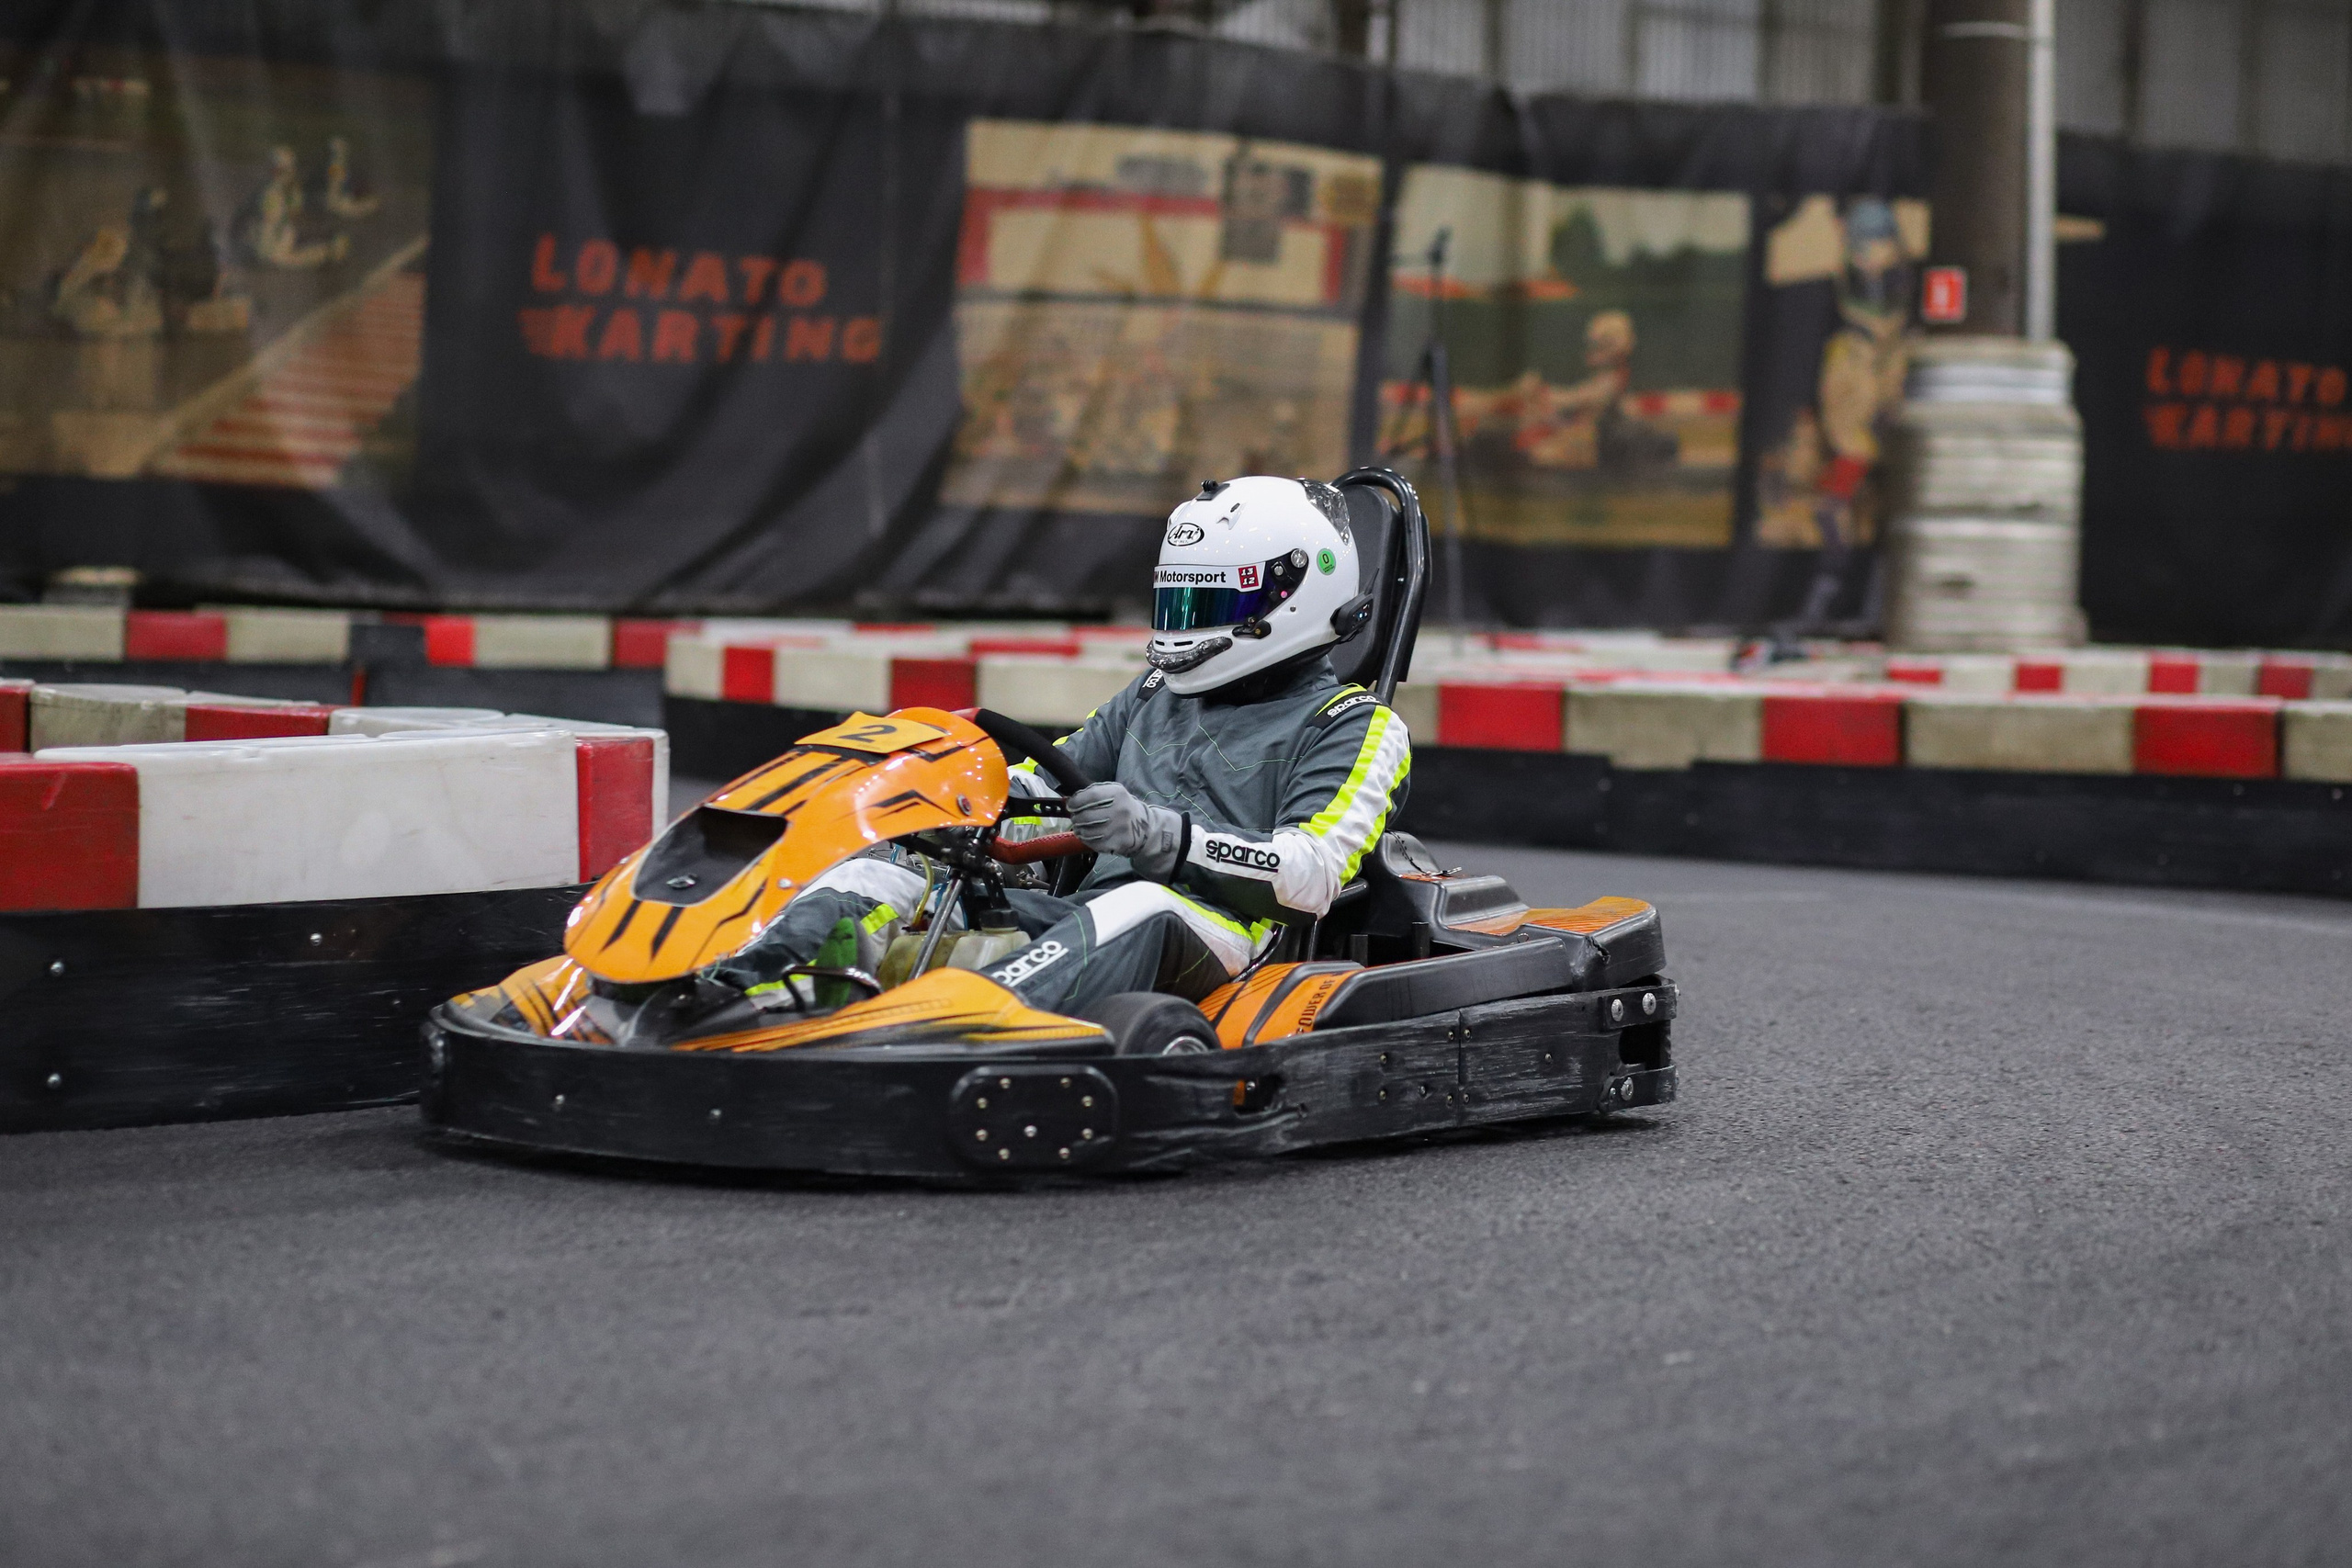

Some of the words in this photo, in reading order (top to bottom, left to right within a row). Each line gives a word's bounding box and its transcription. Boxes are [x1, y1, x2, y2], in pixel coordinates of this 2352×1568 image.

[531, 231, 828, 307] LONATO
[516, 304, 883, 364] KARTING
[2146, 346, 2347, 406] LONATO
[1168, 525, 1201, 541] Arai
[1159, 570, 1227, 585] Motorsport
[1241, 568, 1254, 576] 13
[1242, 577, 1255, 585] 12
[1327, 695, 1381, 717] sparco
[836, 724, 898, 743] 2
[1205, 840, 1280, 873] sparco
[991, 941, 1069, 987] parco
